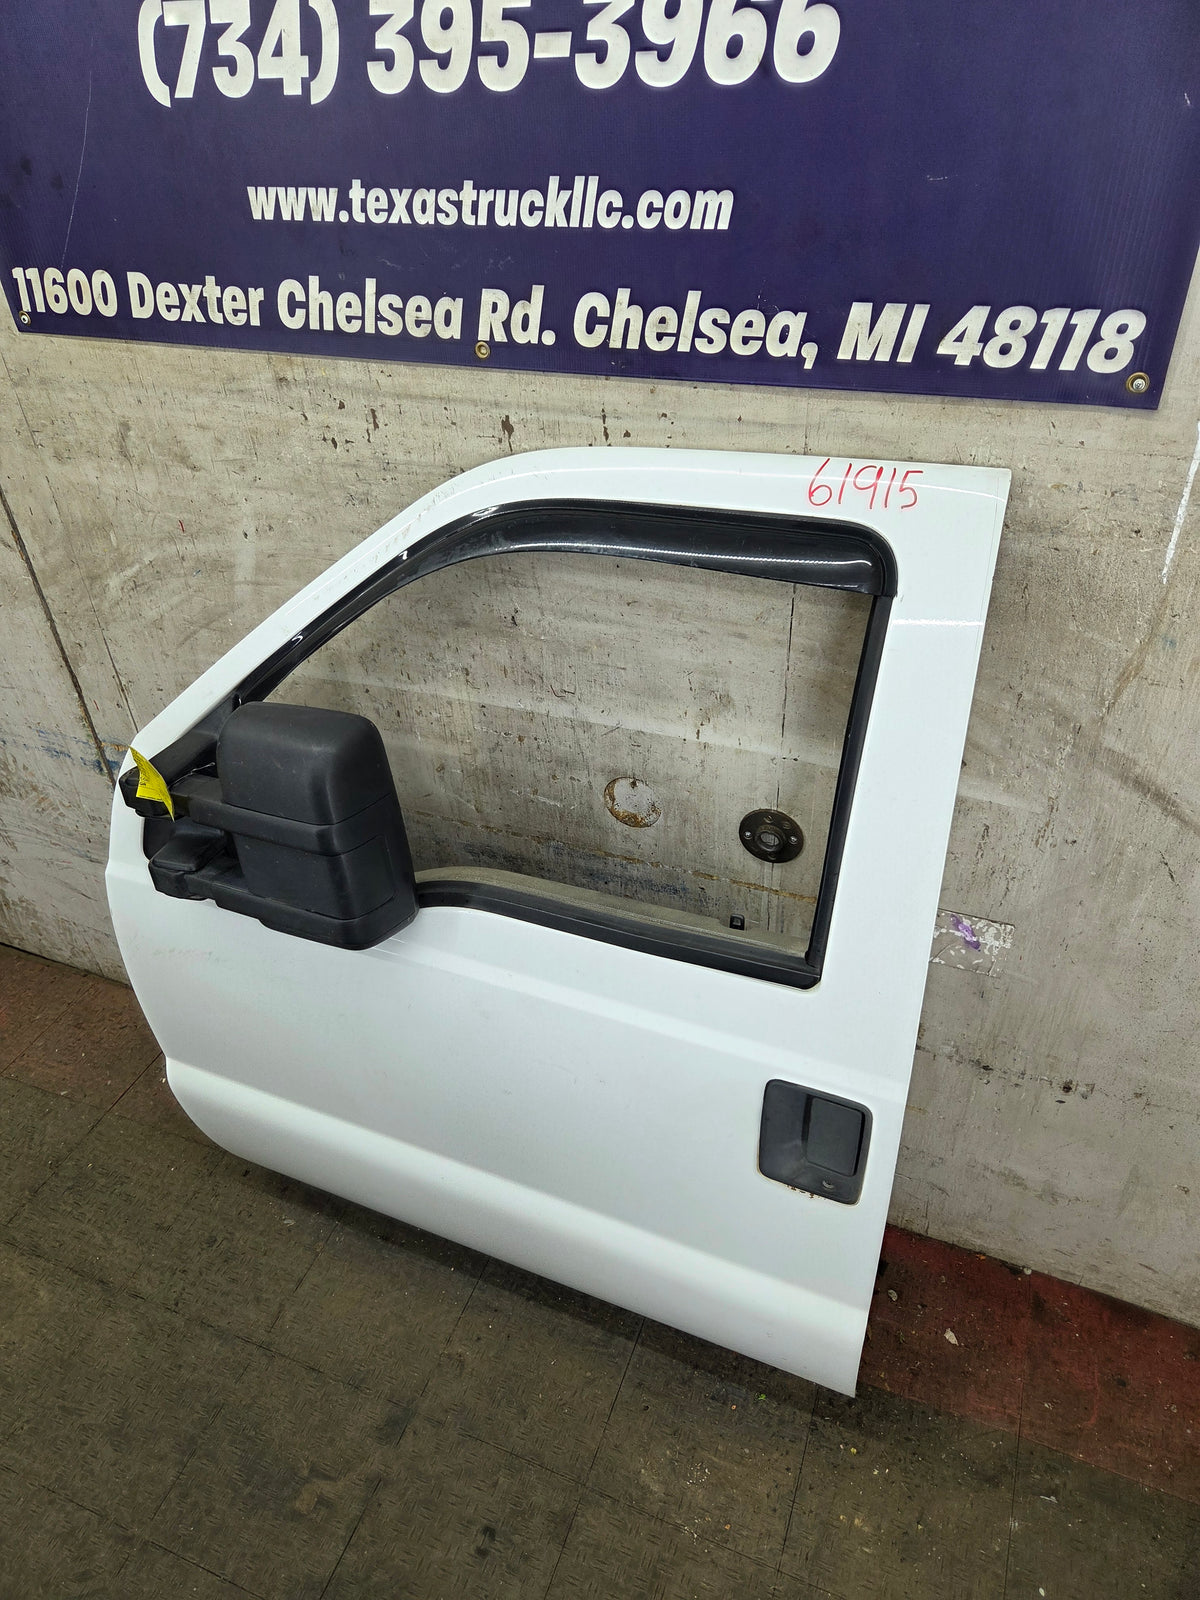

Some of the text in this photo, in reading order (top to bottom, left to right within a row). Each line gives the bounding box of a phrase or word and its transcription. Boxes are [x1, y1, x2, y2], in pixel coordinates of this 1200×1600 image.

[138, 0, 840, 107] (734) 395-3966
[247, 176, 733, 229] www.texastruckllc.com
[12, 267, 1146, 373] 11600 Dexter Chelsea Rd. Chelsea, MI 48118
[808, 457, 924, 510] 61915
